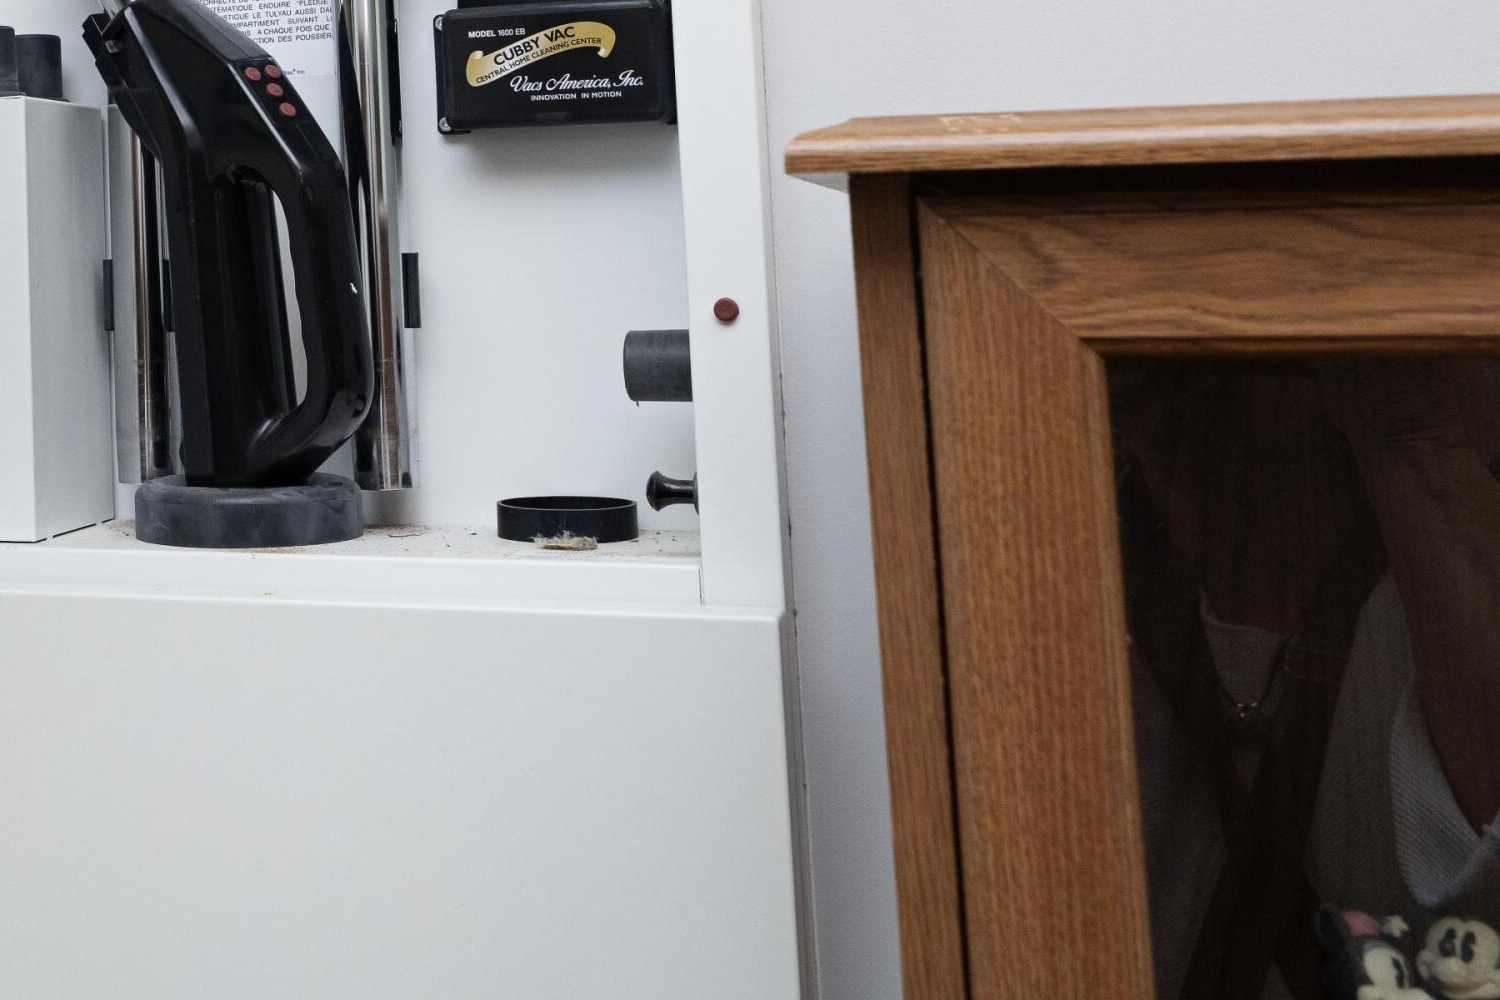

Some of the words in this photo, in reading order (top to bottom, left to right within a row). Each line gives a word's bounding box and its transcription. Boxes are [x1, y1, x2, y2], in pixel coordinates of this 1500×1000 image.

[258, 1, 290, 9] ENDUIRE
[265, 10, 291, 18] TULYAU
[295, 7, 316, 15] AUSSI
[287, 16, 318, 24] SUIVANT
[263, 26, 293, 35] CHAQUE
[314, 23, 329, 31] QUE
[468, 29, 496, 39] MODEL
[497, 28, 514, 37] 1600
[515, 27, 526, 36] EB
[277, 35, 292, 43] DES
[493, 36, 542, 66] CUBBY
[544, 25, 576, 43] VAC
[475, 64, 508, 85] CENTRAL
[509, 55, 531, 69] HOME
[530, 41, 570, 59] CLEANING
[570, 36, 602, 48] CENTER
[509, 75, 543, 93] Vacs
[545, 73, 611, 91] America,
[612, 69, 644, 87] Inc.
[530, 91, 577, 102] INNOVATION
[581, 91, 590, 99] IN
[591, 90, 622, 99] MOTION
